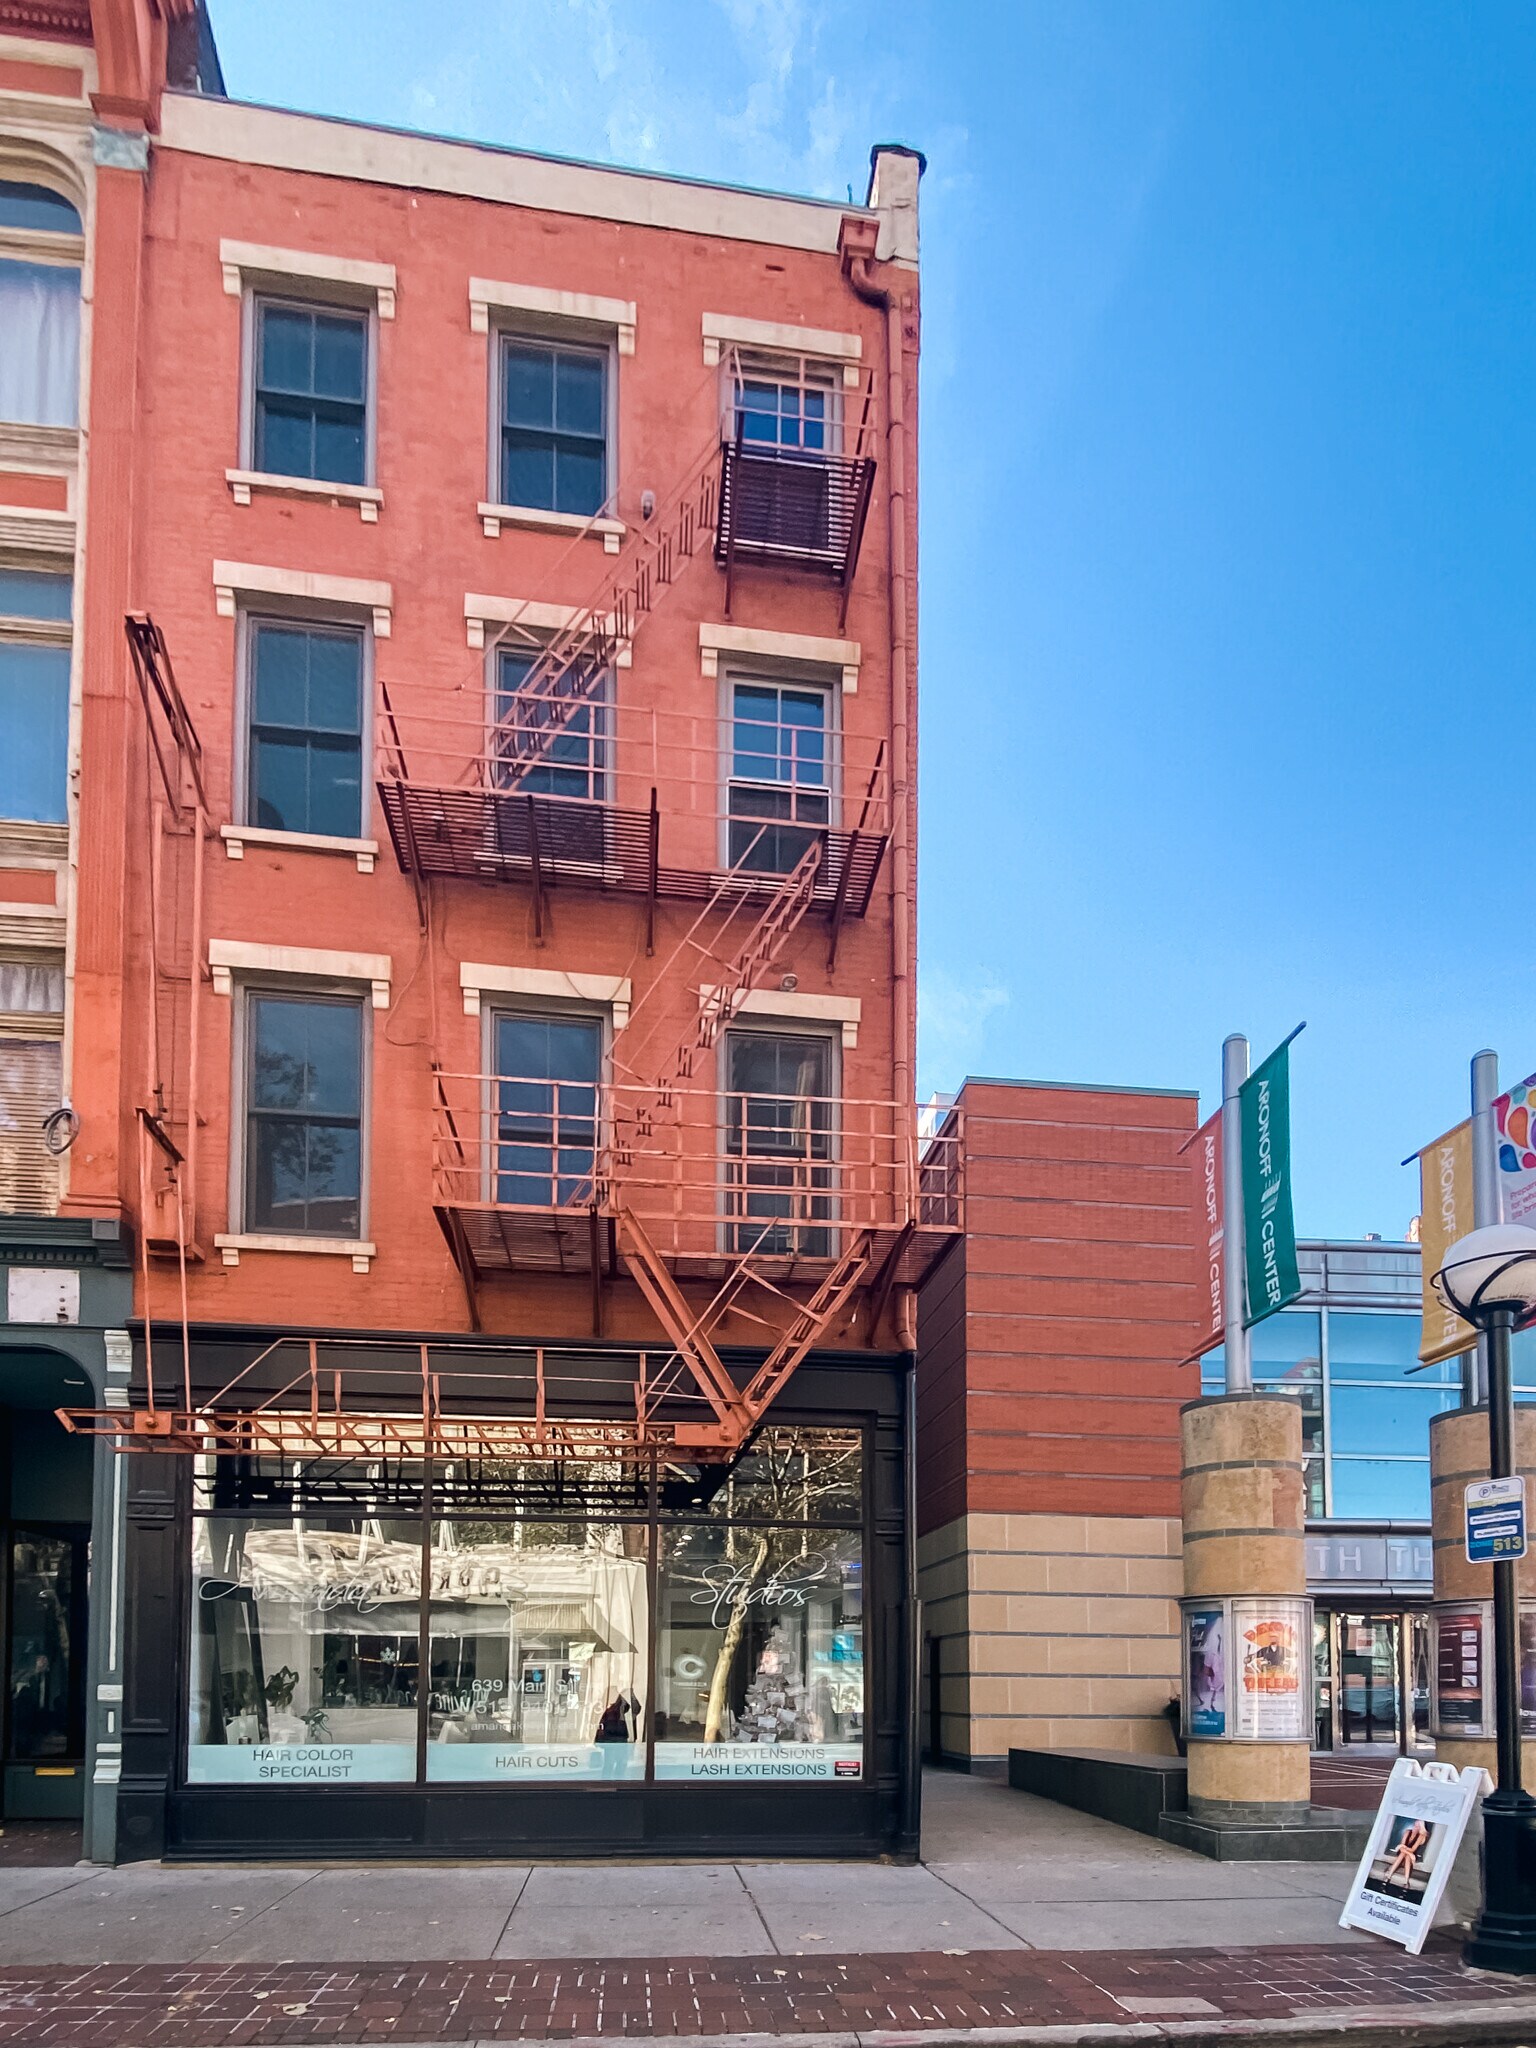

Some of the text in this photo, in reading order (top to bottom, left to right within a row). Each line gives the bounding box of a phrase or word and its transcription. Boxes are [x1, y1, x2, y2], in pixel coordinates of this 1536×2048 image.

[1258, 1079, 1281, 1307] ARONOFF CENTER
[1440, 1147, 1457, 1232] ARONOFF
[1205, 1135, 1222, 1333] ARONOFF CENTE
[1494, 1536, 1522, 1551] 513
[690, 1552, 828, 1629] Studios
[471, 1679, 503, 1692] 639
[253, 1749, 353, 1761] HAIR COLOR
[693, 1748, 825, 1759] HAIR EXTENSIONS
[496, 1756, 578, 1768] HAIR CUTS
[691, 1764, 729, 1775] LASH
[735, 1764, 827, 1775] EXTENSIONS
[259, 1766, 352, 1778] SPECIALIST
[1360, 1891, 1419, 1916] Gift Certificates
[1367, 1907, 1401, 1925] Available
